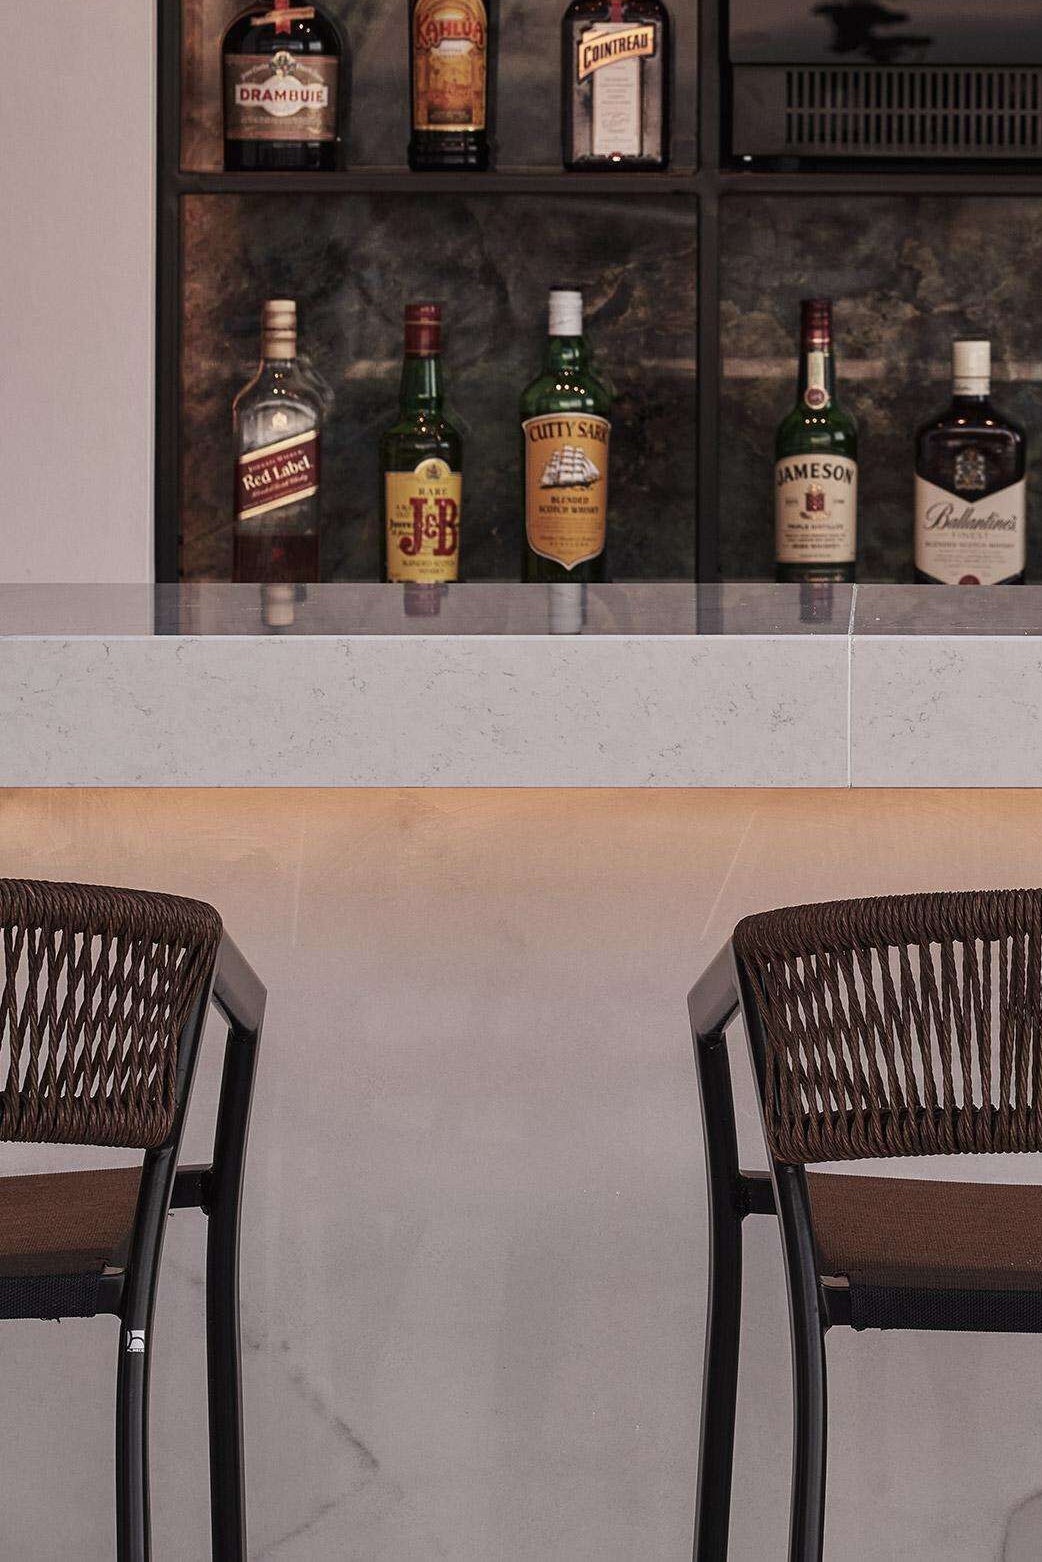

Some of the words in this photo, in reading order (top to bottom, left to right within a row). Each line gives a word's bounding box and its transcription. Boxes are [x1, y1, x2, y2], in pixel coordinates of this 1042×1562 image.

[583, 33, 649, 70] COINTREAU
[241, 88, 324, 102] DRAMBUIE
[529, 422, 576, 443] CUTTY
[577, 422, 607, 445] SARK
[243, 469, 272, 491] Red
[272, 455, 311, 480] Label
[777, 462, 854, 487] JAMESON
[399, 498, 458, 556] J&B
[924, 502, 1018, 532] Ballantine's
